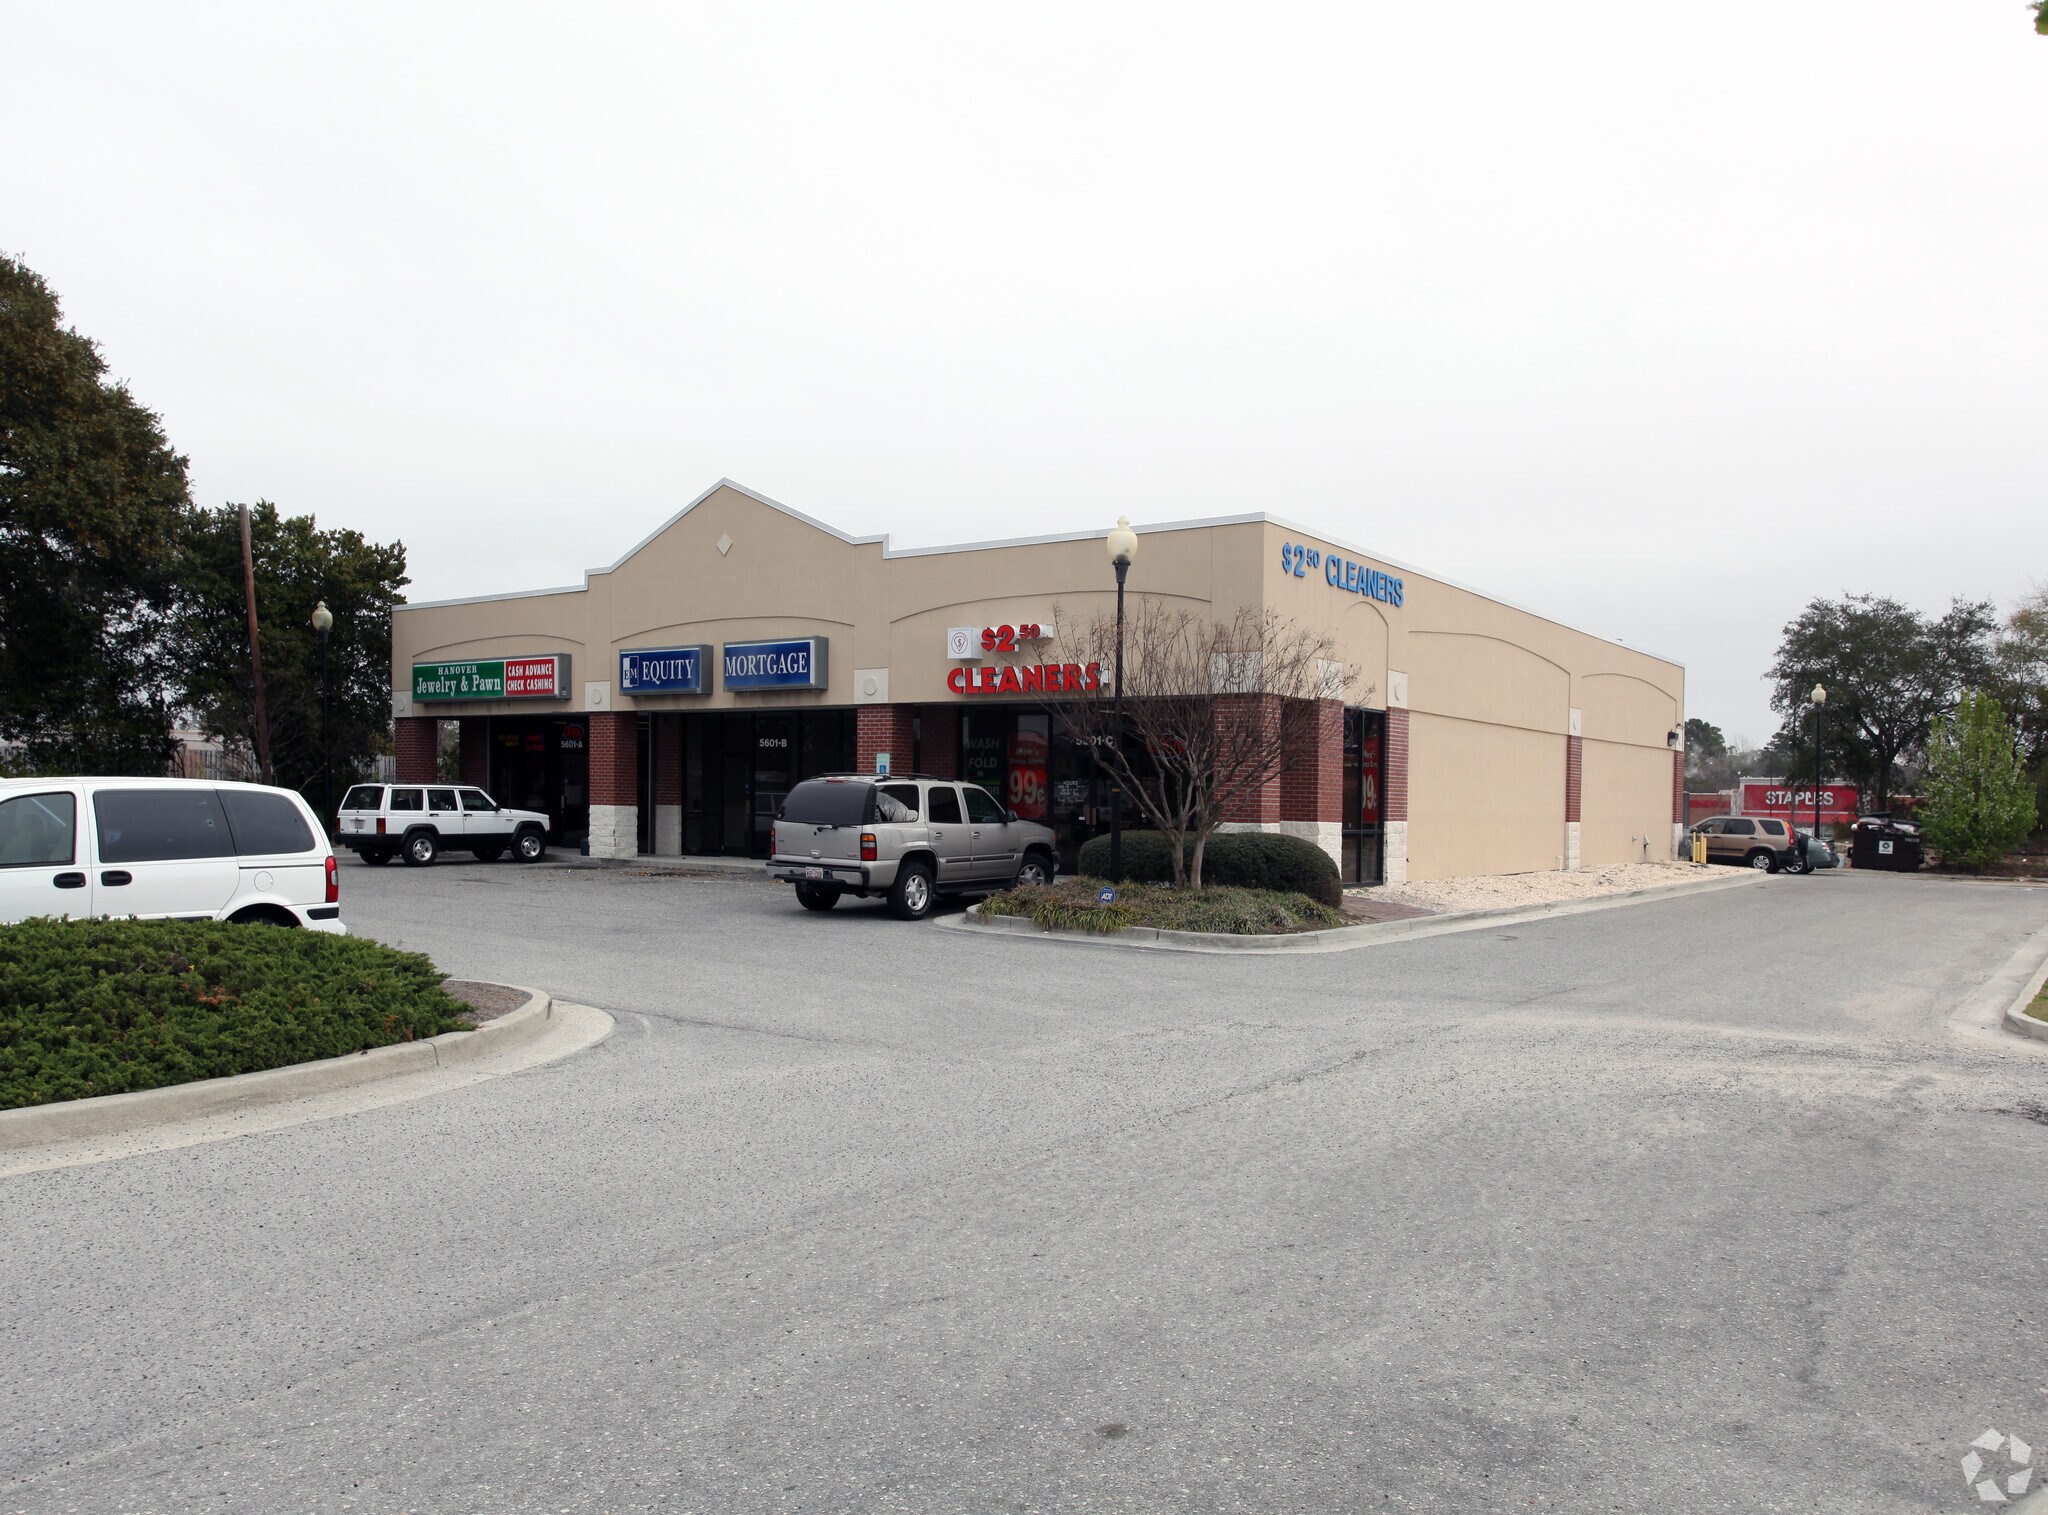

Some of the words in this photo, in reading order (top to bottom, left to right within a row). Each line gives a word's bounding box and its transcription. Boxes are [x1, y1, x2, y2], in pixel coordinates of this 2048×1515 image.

[1325, 554, 1404, 607] CLEANERS
[437, 665, 477, 675] HANOVER
[507, 665, 524, 677] CASH
[525, 663, 553, 675] ADVANCE
[642, 658, 695, 685] EQUITY
[725, 652, 808, 677] MORTGAGE
[416, 676, 457, 696] Jewelry
[460, 677, 469, 692] &
[472, 674, 502, 692] Pawn
[507, 679, 525, 691] CHECK
[526, 678, 553, 690] CASHING
[947, 662, 1101, 695] CLEANERS
[968, 738, 1000, 749] WASH
[968, 757, 998, 769] FOLD
[1101, 892, 1113, 900] ADT
